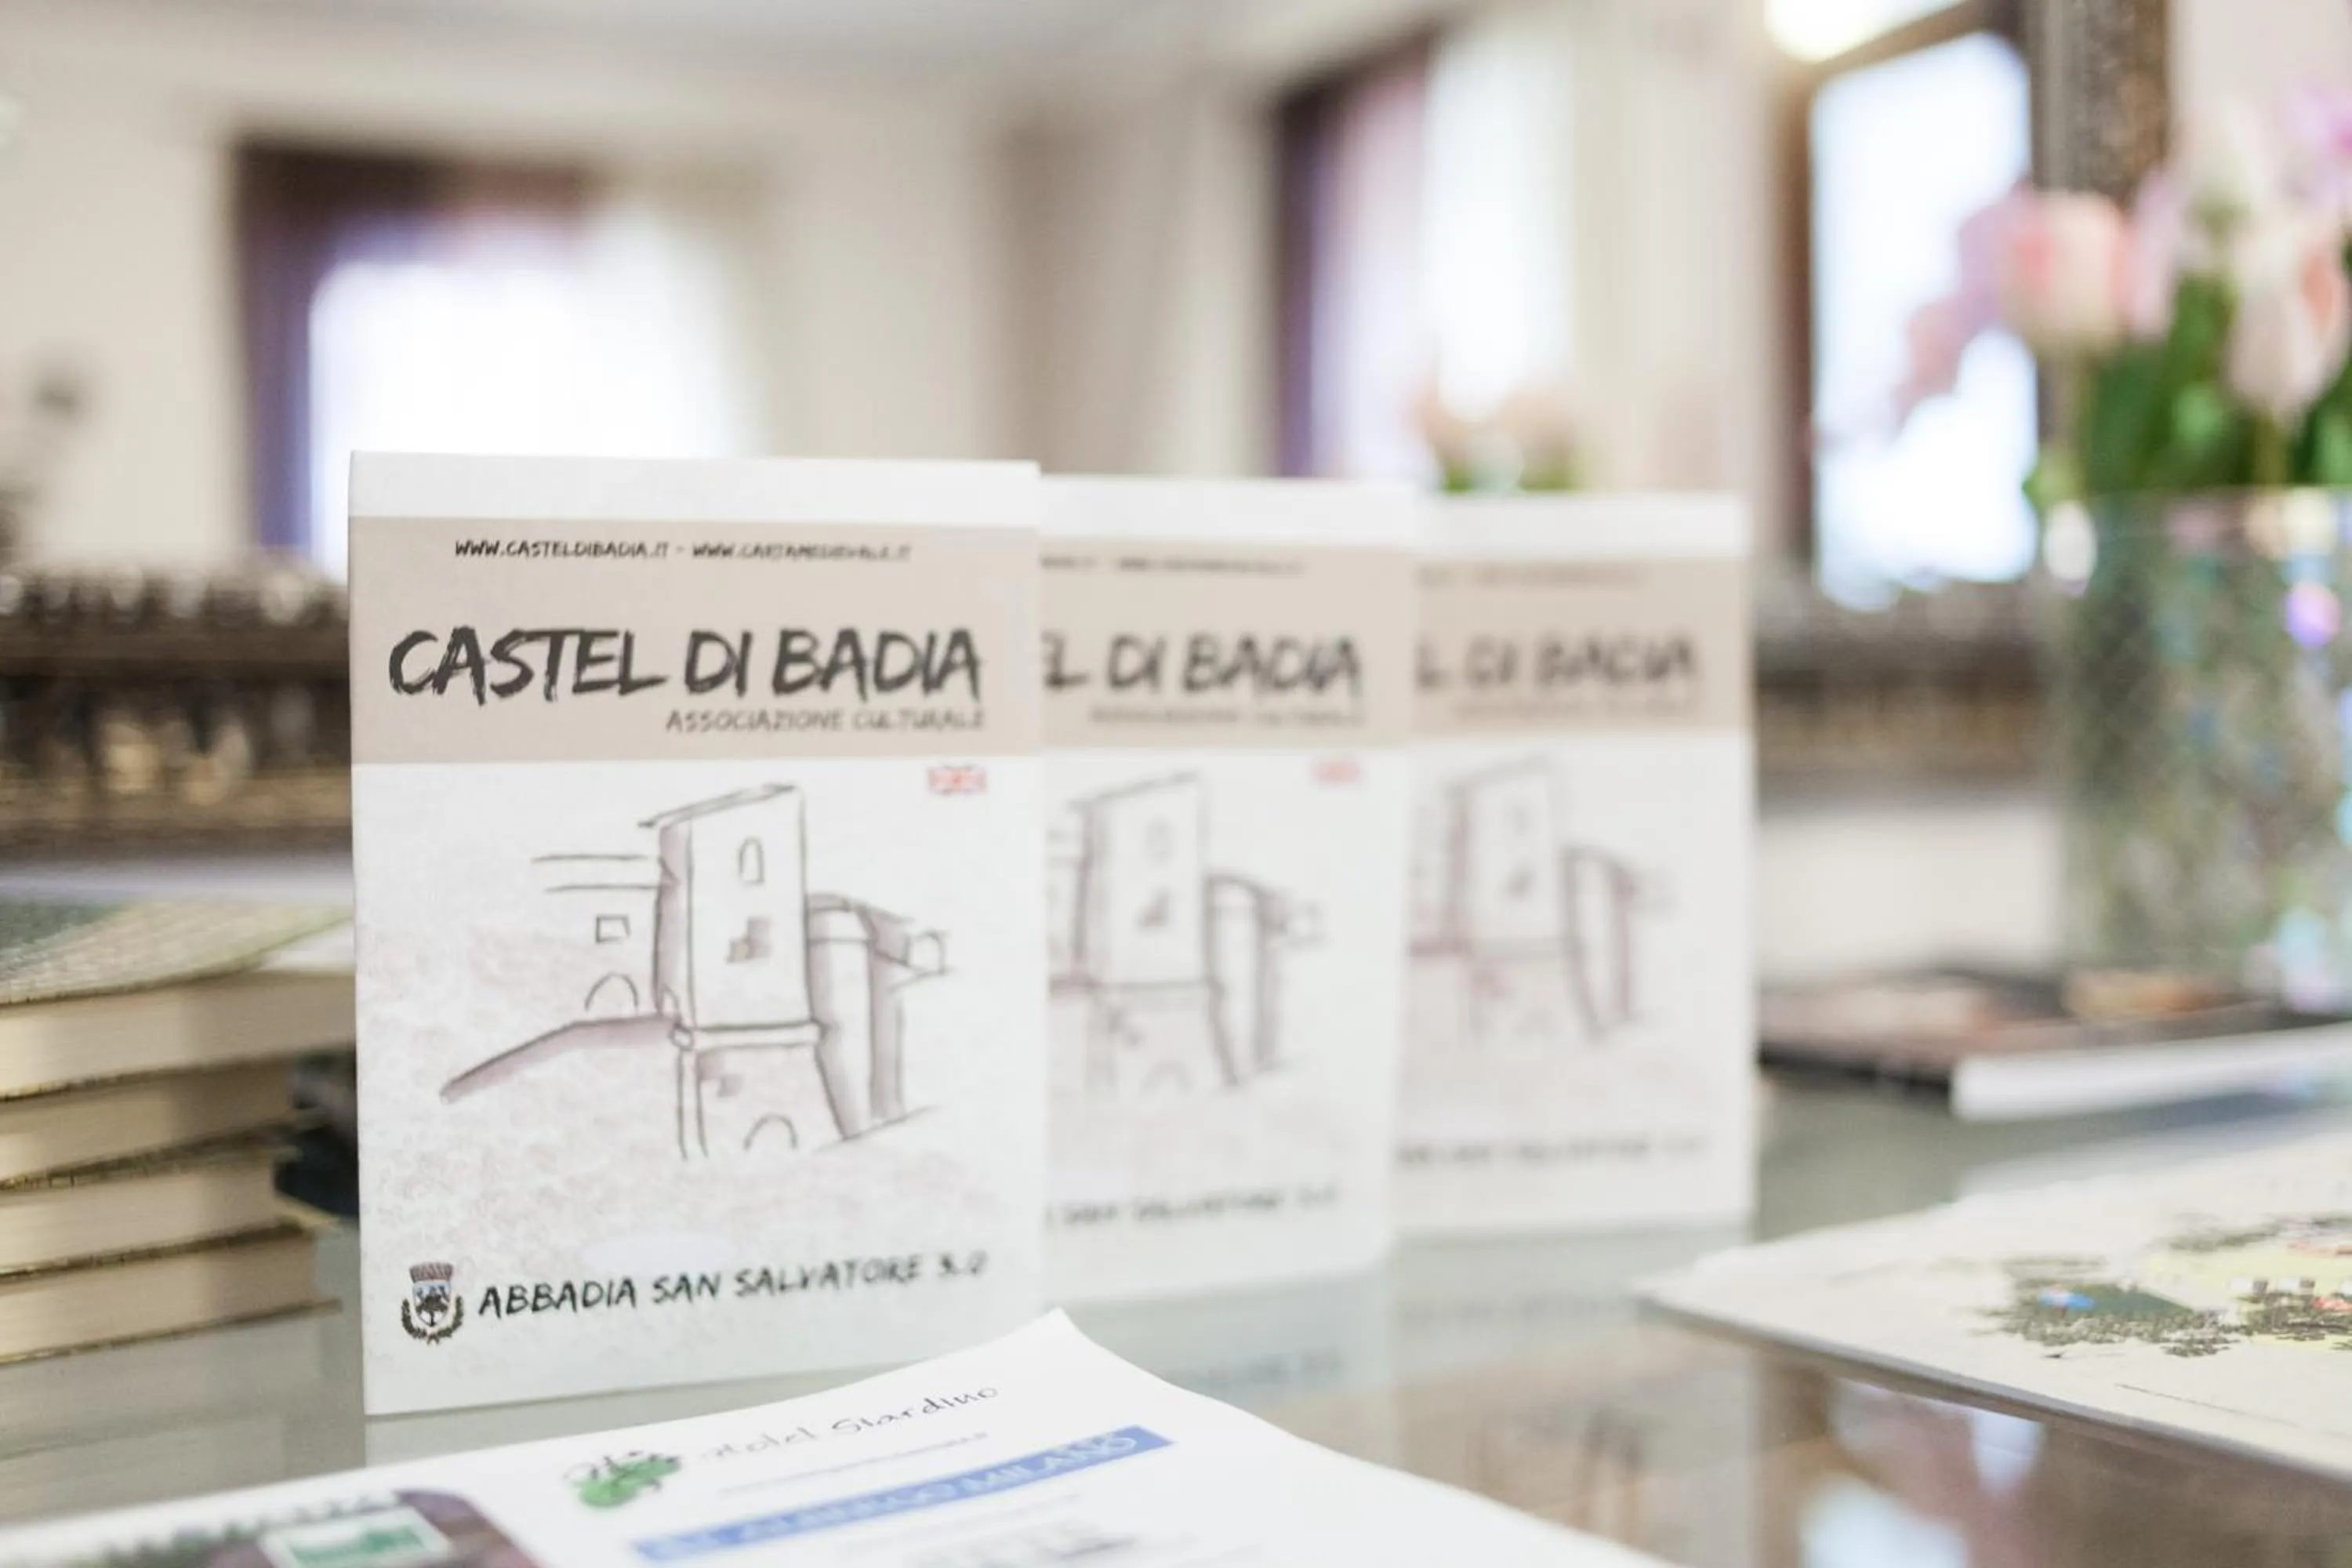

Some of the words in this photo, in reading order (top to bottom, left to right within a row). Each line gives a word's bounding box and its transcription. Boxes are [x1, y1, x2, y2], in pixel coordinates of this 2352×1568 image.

[455, 539, 669, 558] WWW.CASTELDIBADIA.IT
[389, 625, 666, 706] CASTEL
[684, 628, 753, 698] DI
[773, 627, 982, 704] BADIA
[1108, 633, 1166, 693] DI
[1182, 631, 1363, 702] BADIA
[665, 709, 844, 732] ASSOCIAZIONE
[851, 710, 986, 731] CULTURALE
[478, 1276, 637, 1319] ABBADIA
[652, 1272, 720, 1305] SAN
[734, 1254, 924, 1298] SALVATORE
